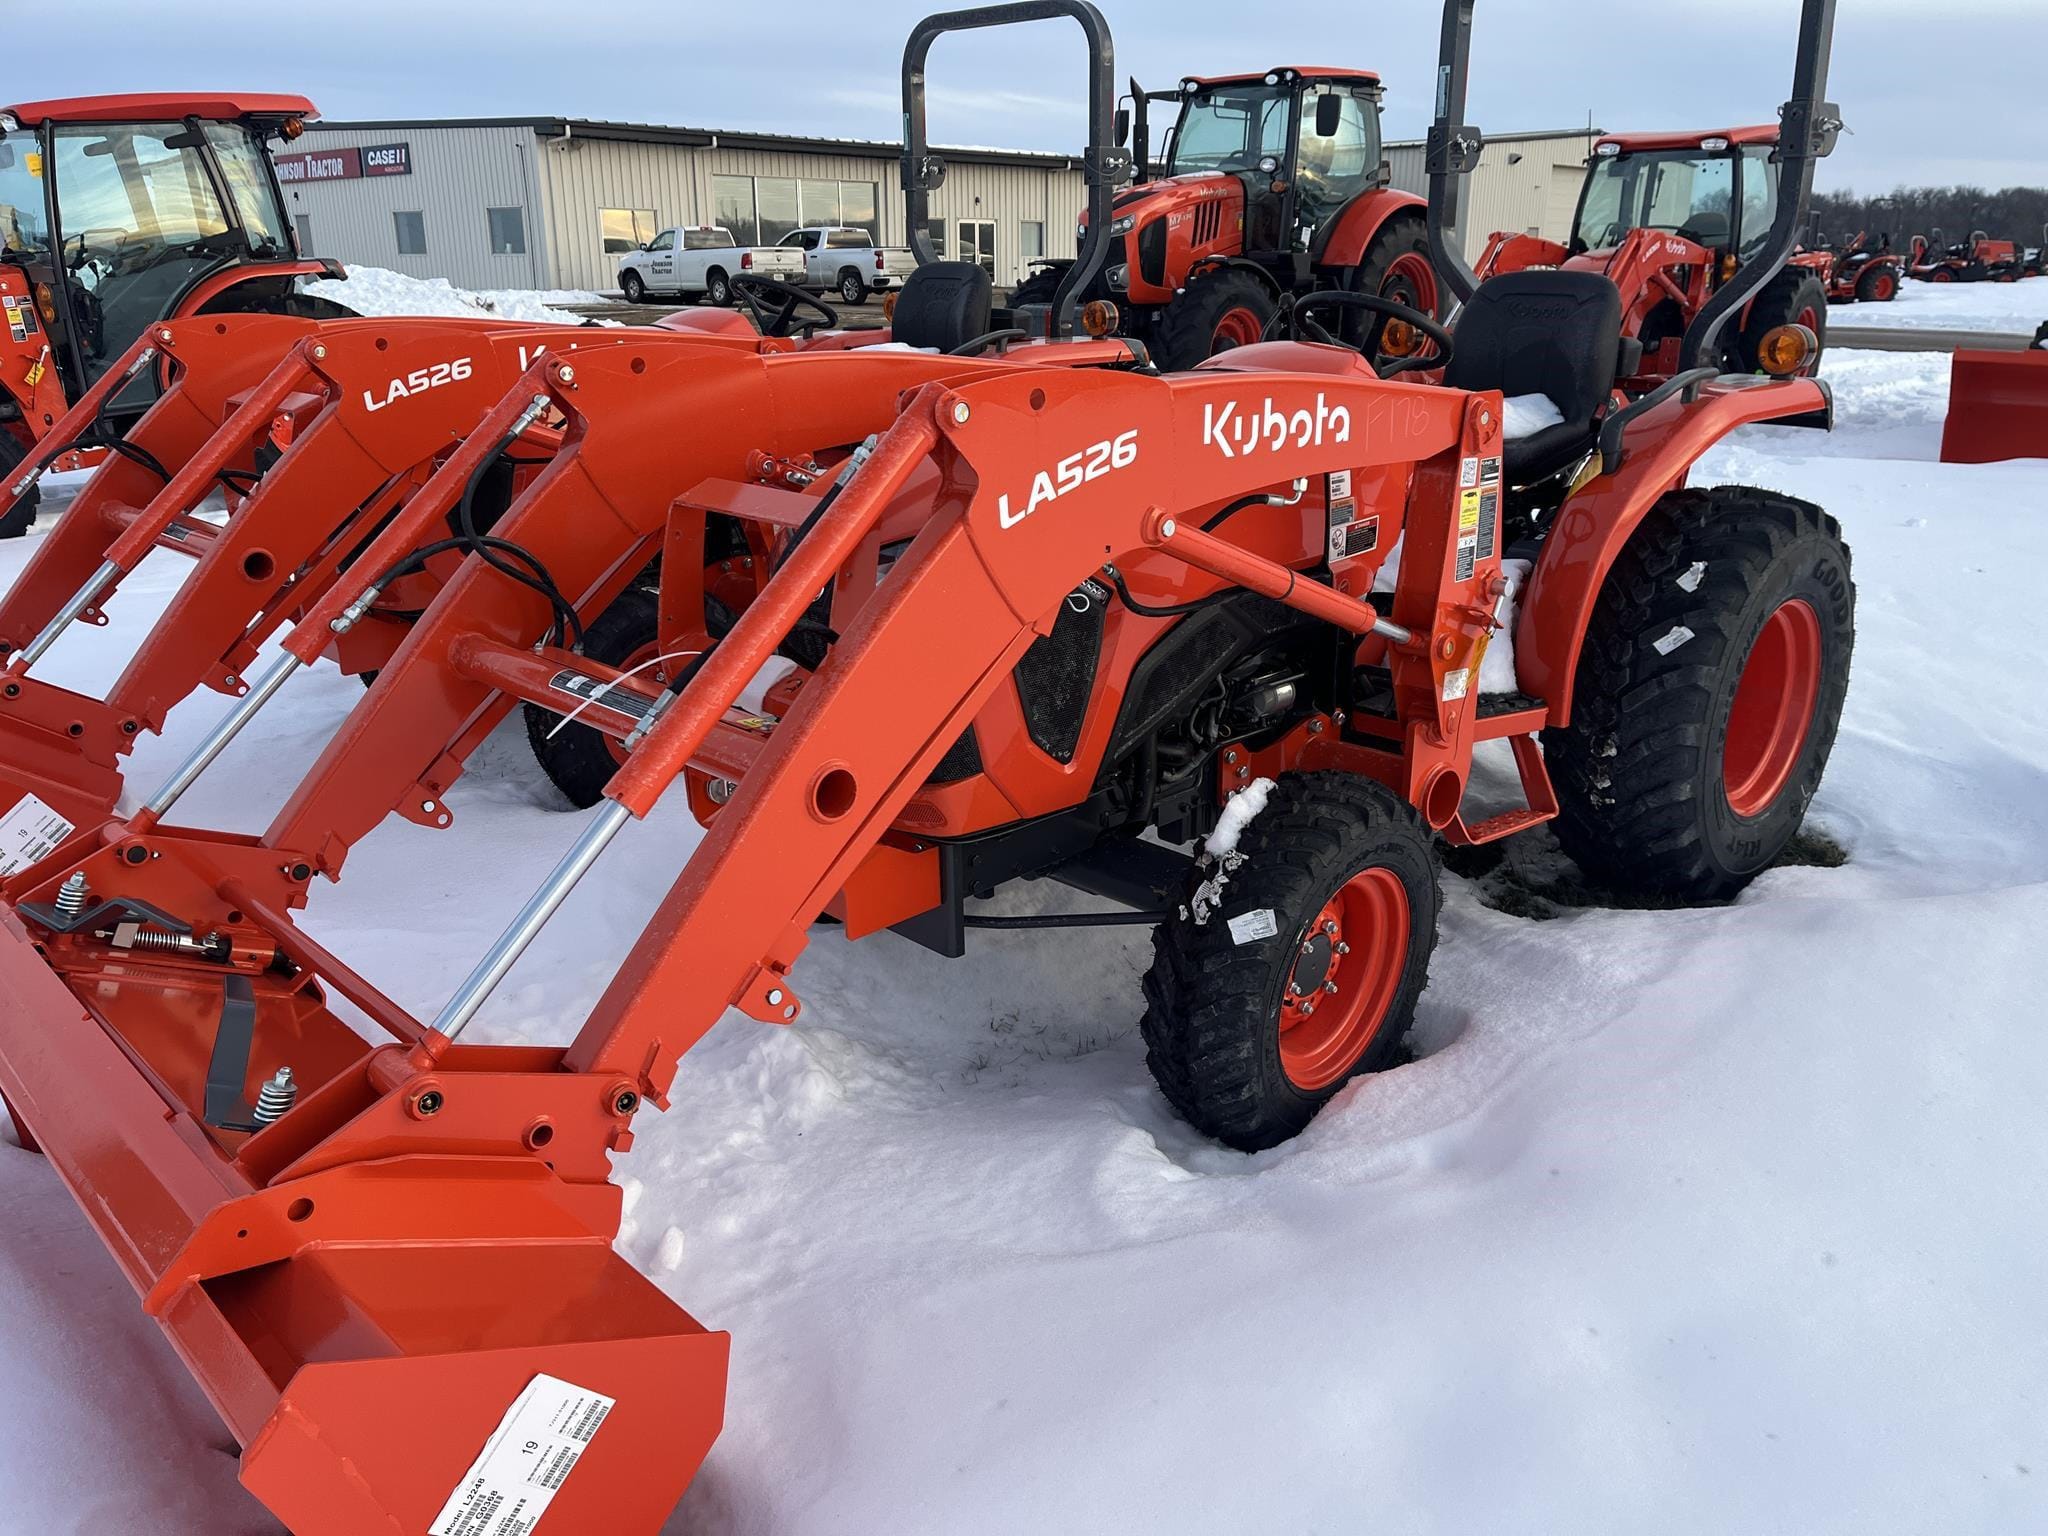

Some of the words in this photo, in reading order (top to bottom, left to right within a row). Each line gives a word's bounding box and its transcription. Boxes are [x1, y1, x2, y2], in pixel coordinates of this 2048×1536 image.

[367, 149, 395, 166] CASE
[363, 357, 472, 412] LA526
[1203, 392, 1351, 458] Kubota
[998, 429, 1138, 530] LA526
[522, 1440, 539, 1455] 19
[444, 1509, 464, 1535] Model
[462, 1478, 486, 1506] L2248
[475, 1490, 499, 1520] G0368
